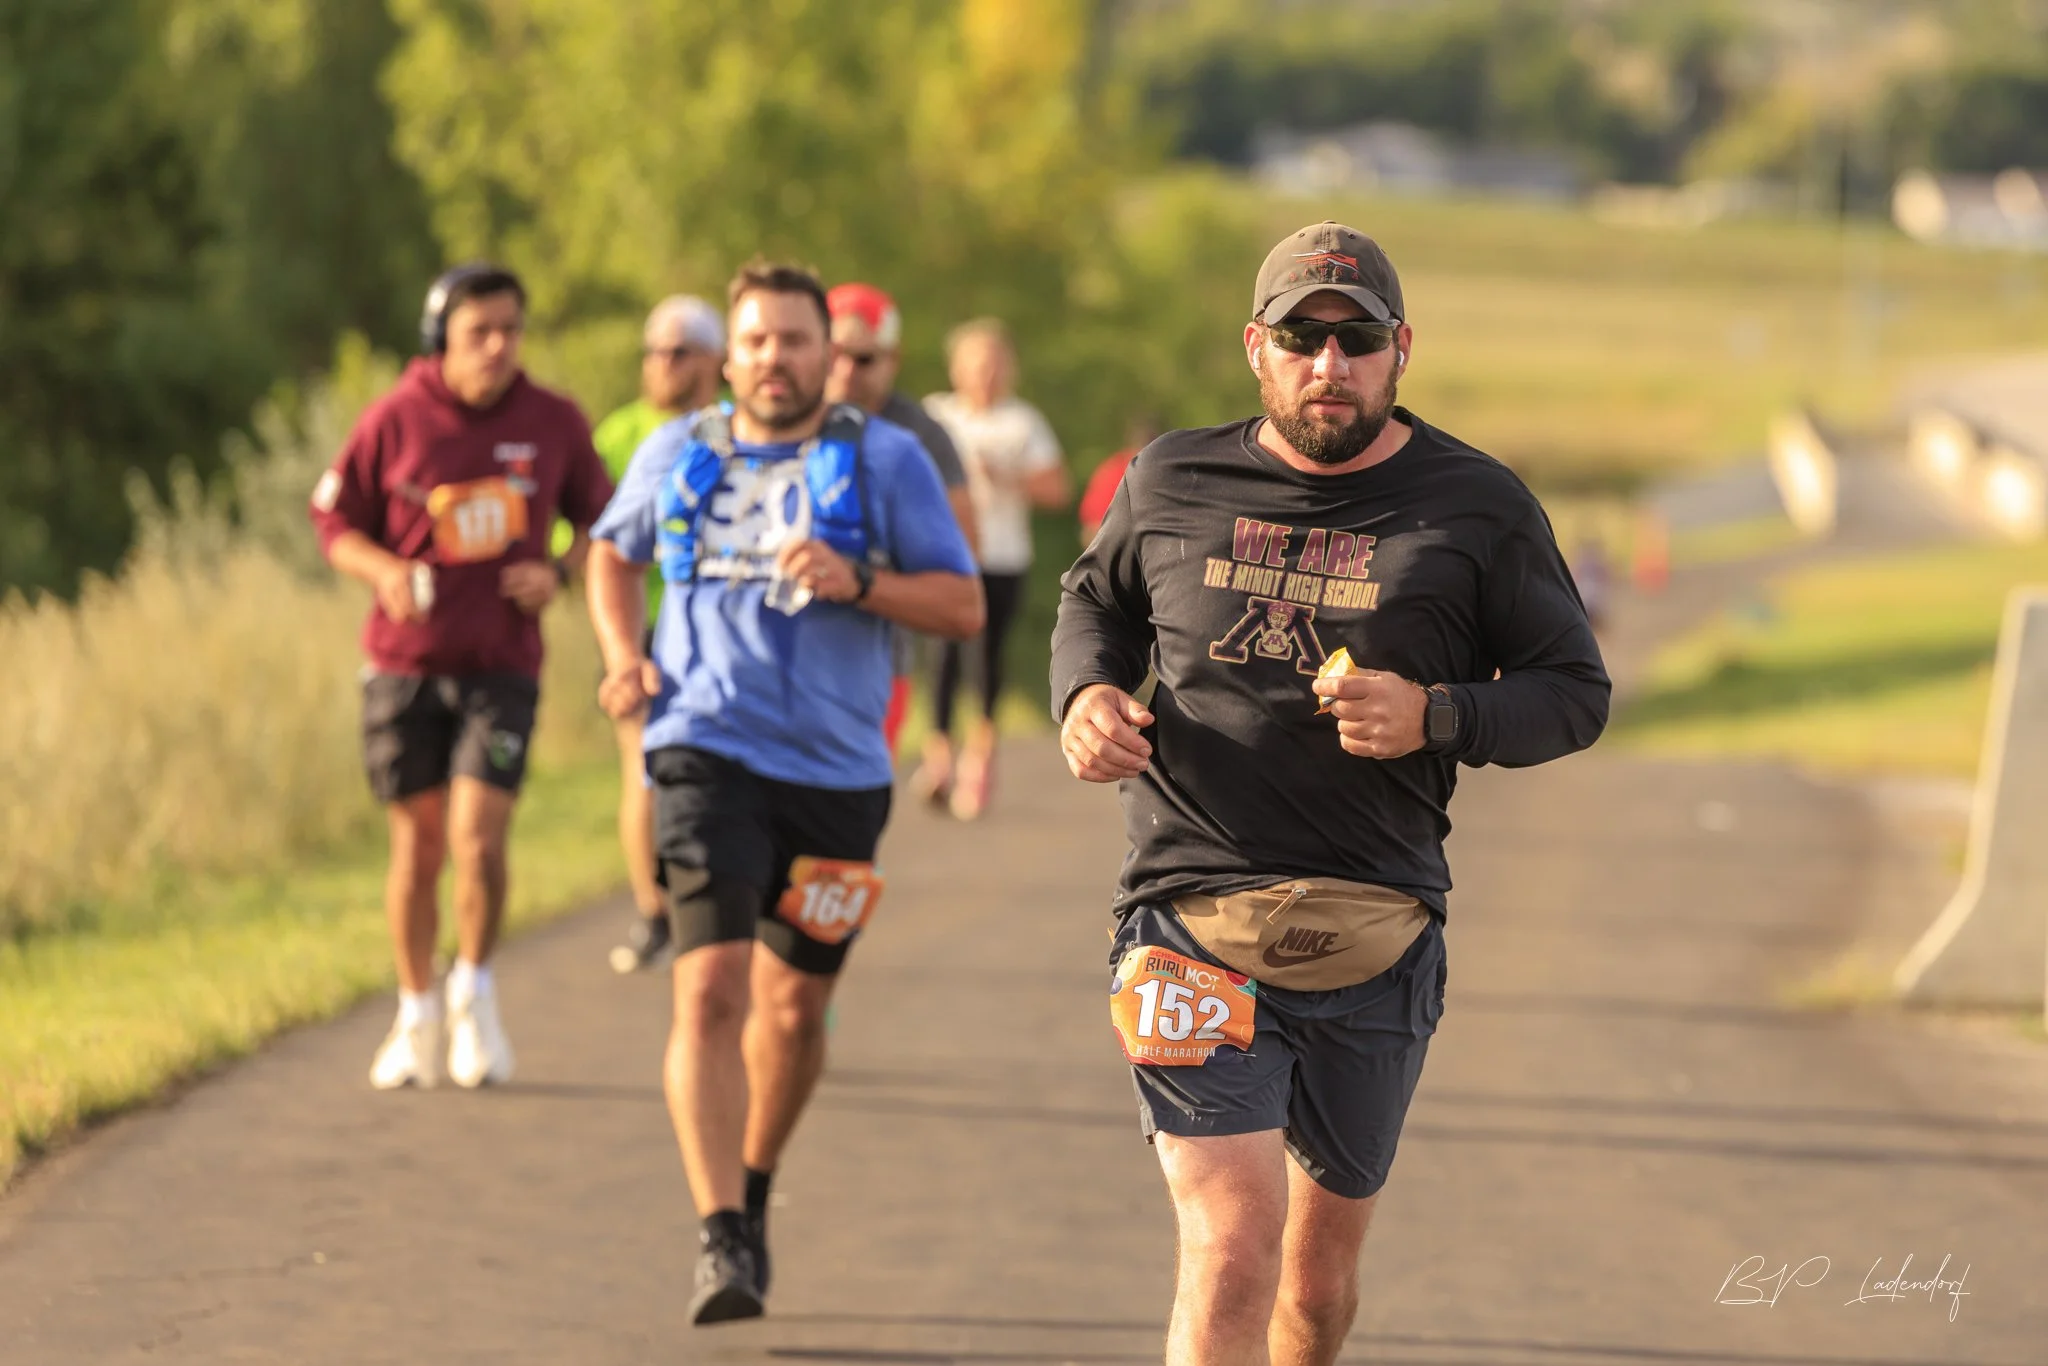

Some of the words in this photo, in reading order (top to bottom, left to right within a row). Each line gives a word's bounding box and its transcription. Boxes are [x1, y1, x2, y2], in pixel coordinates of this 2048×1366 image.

[1232, 517, 1293, 568] WE
[1297, 528, 1377, 579] ARE
[1203, 557, 1233, 588] THE
[1231, 564, 1285, 597] MINOT
[1282, 572, 1323, 605] HIGH
[1321, 578, 1381, 611] SCHOOL
[799, 882, 870, 926] 164
[1277, 926, 1340, 954] NIKE
[1132, 978, 1231, 1042] 152
[1136, 1044, 1162, 1057] HALF
[1163, 1046, 1217, 1059] MARATHON
